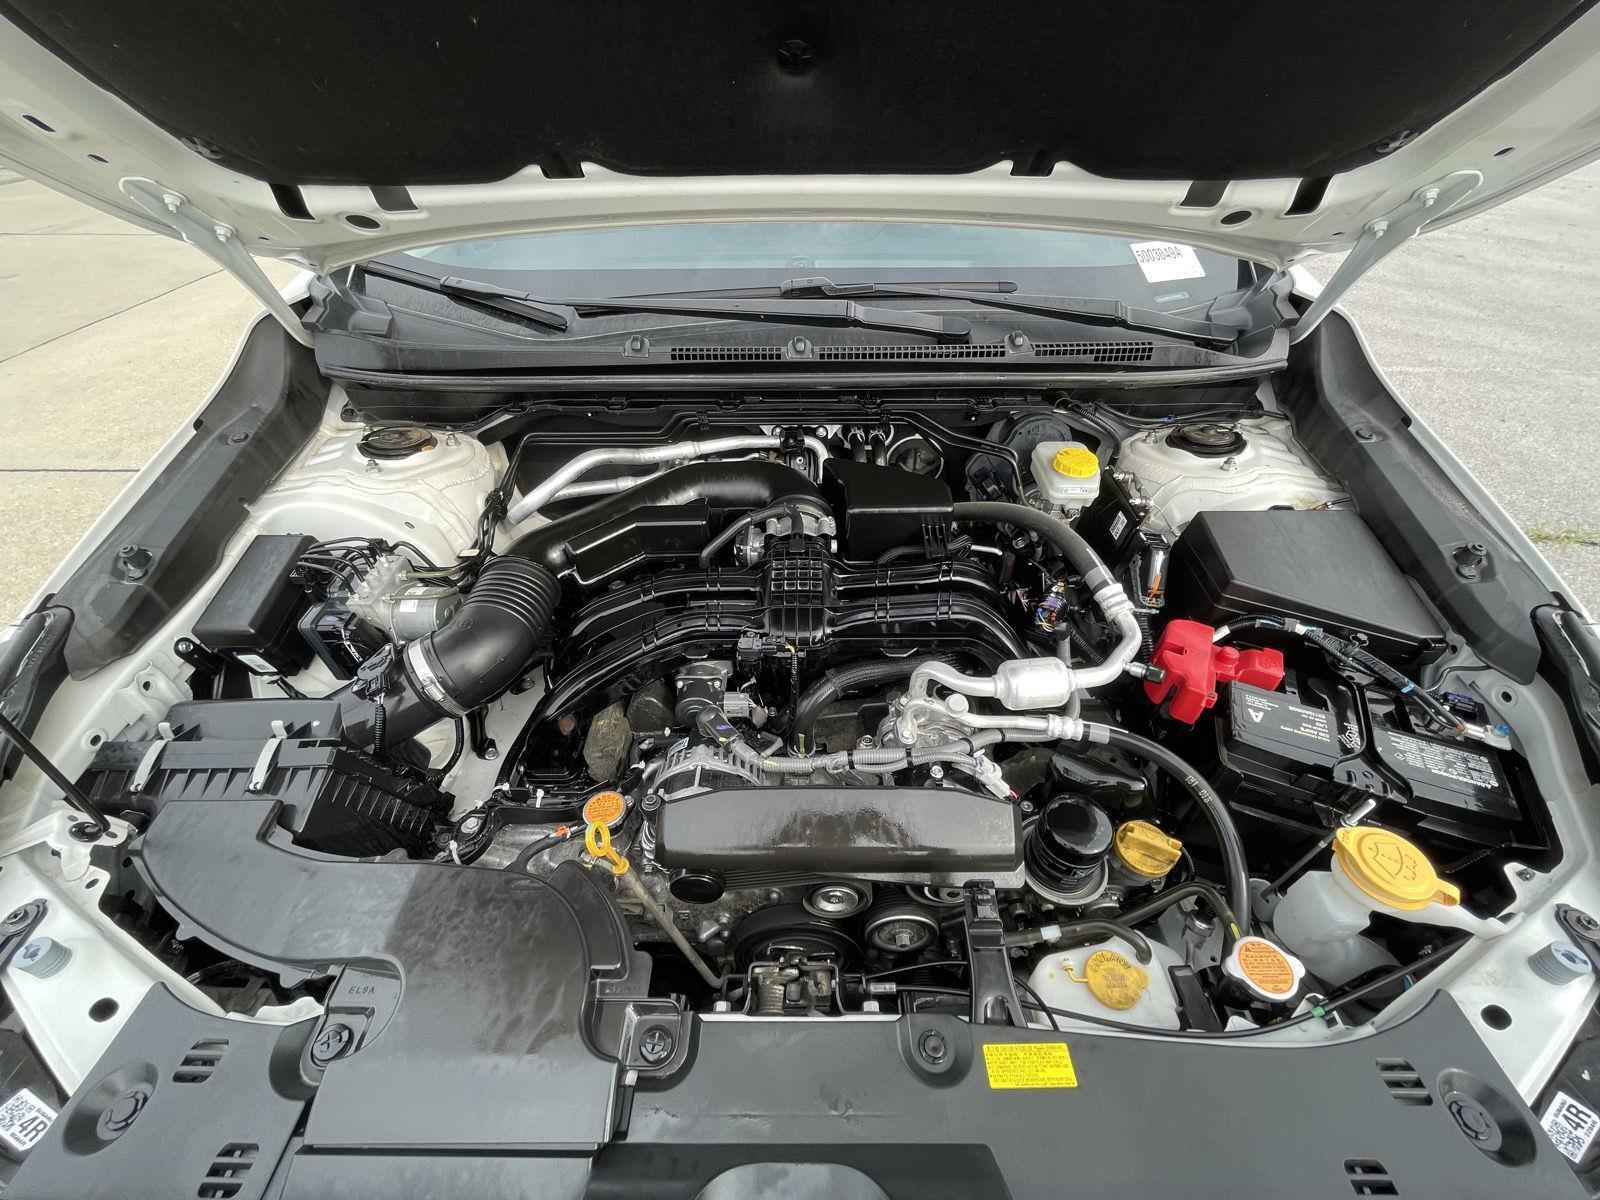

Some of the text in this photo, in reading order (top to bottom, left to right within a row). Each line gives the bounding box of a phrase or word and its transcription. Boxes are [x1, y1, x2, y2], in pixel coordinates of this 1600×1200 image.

[1247, 707, 1265, 723] A
[19, 1116, 48, 1142] 4R
[1562, 1104, 1591, 1130] 4R
